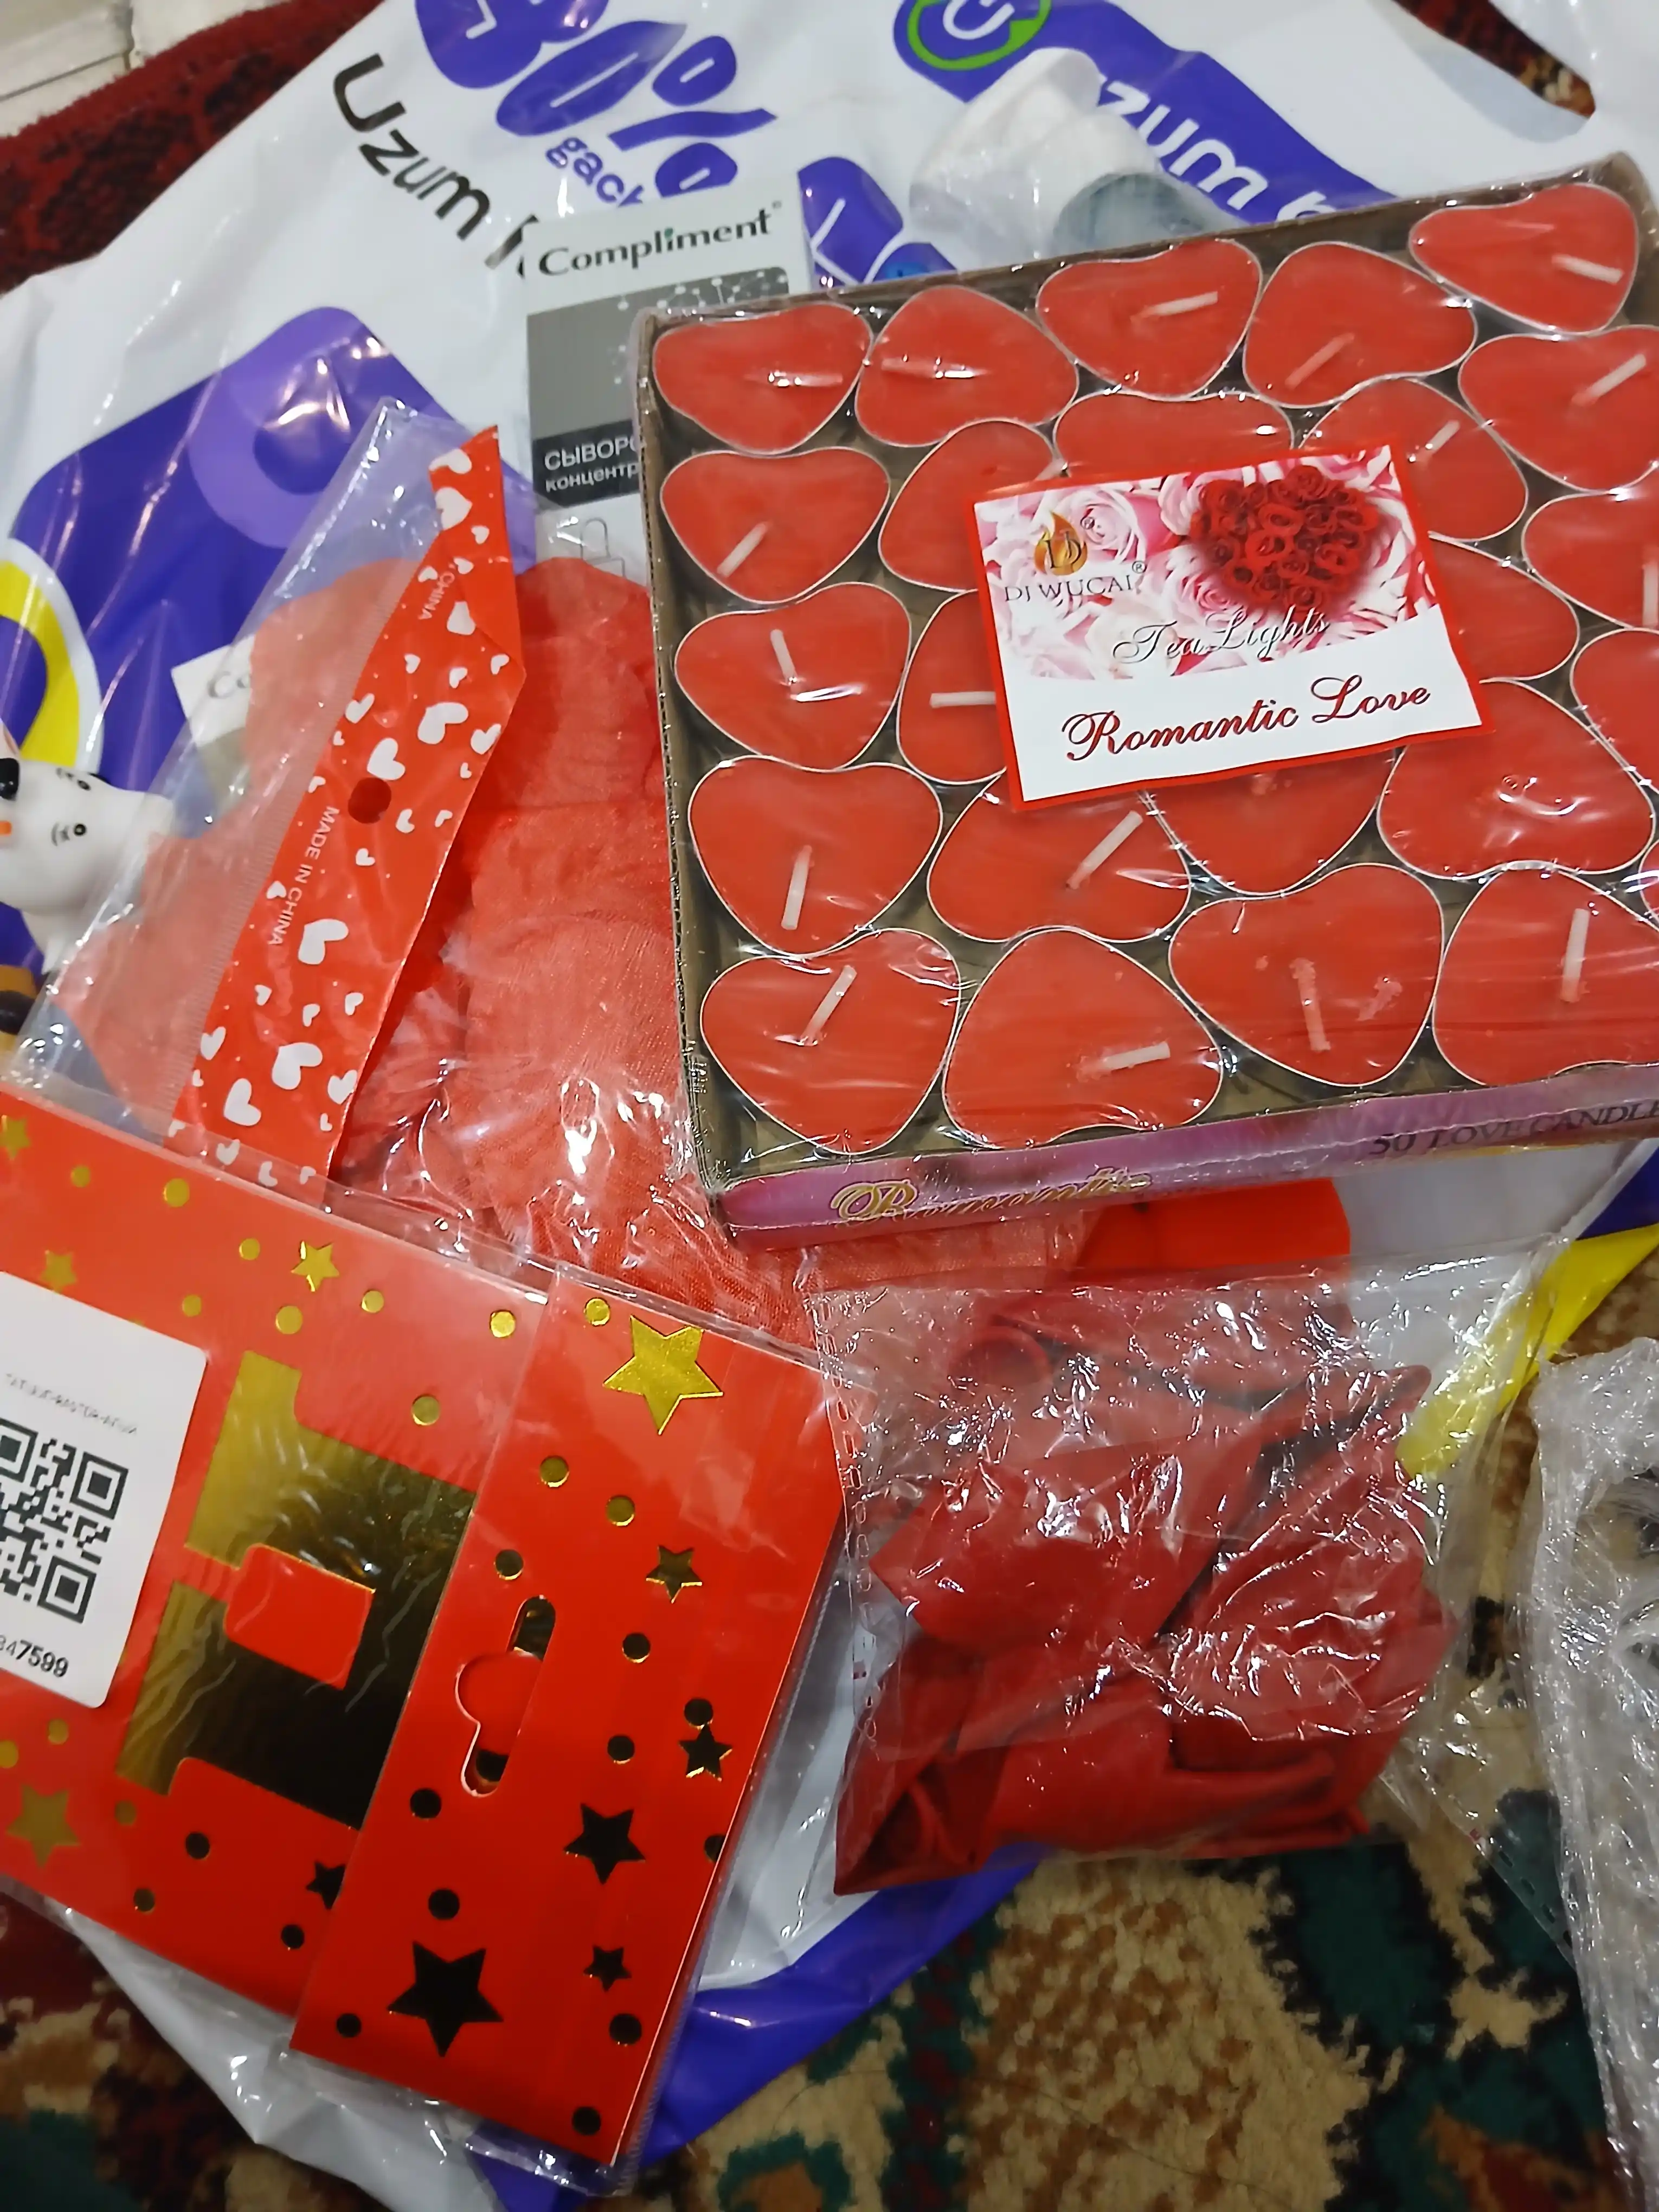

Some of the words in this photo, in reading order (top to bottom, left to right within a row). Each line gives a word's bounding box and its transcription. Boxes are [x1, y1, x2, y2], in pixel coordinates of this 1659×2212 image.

[333, 53, 491, 240] Uzum
[1113, 620, 1210, 664] Tea
[1205, 604, 1331, 661] Lights
[1062, 699, 1299, 761] Romantic
[1310, 674, 1431, 723] Love
[305, 806, 340, 860] MADE
[294, 863, 313, 884] IN
[267, 887, 303, 945] CHINA
